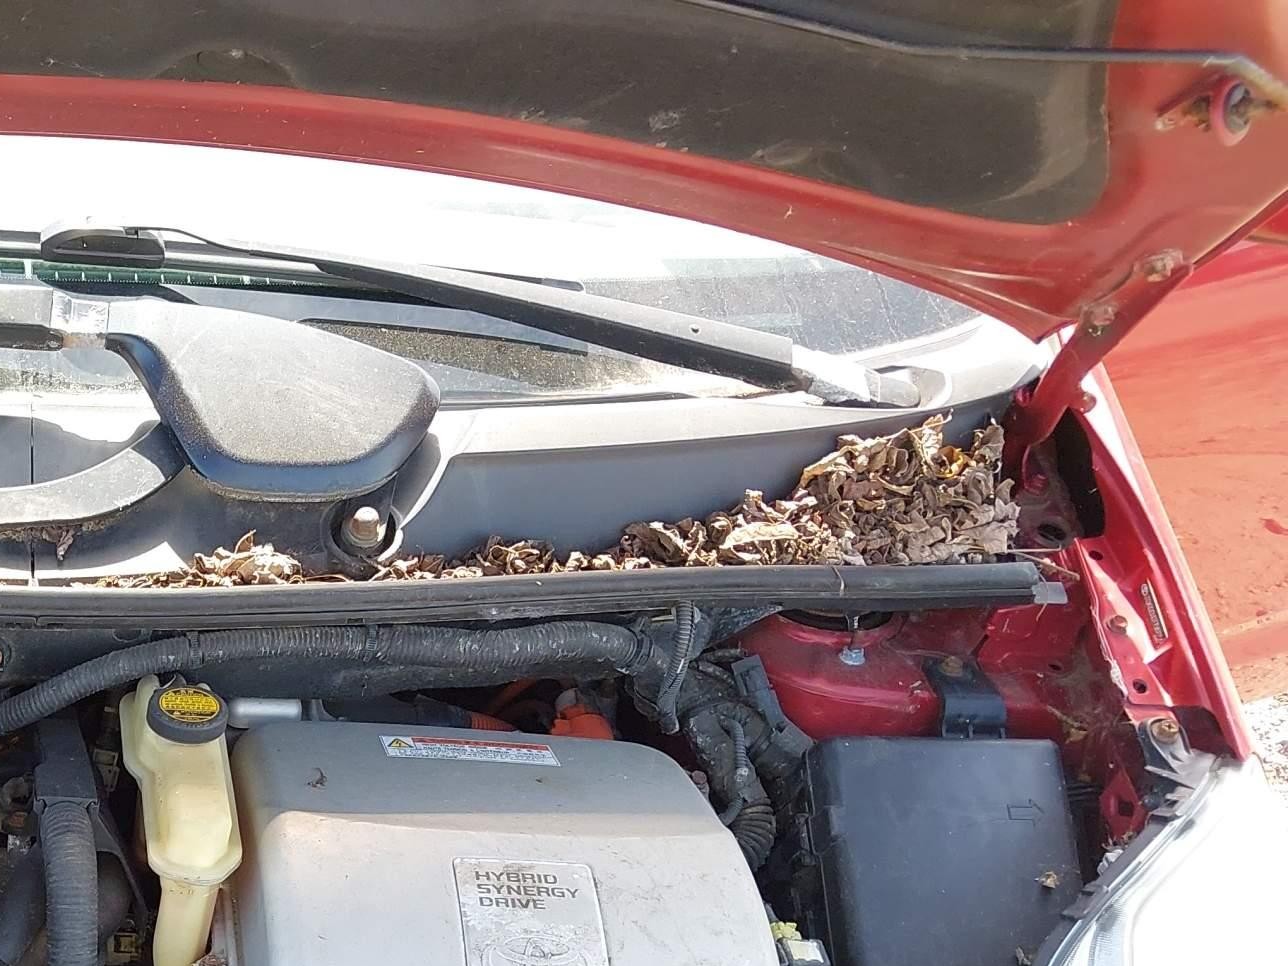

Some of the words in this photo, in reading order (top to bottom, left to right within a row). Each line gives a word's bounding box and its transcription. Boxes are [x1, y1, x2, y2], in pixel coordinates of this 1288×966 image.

[475, 871, 558, 884] HYBRID
[477, 883, 578, 898] SYNERGY
[479, 896, 546, 909] DRIVE
